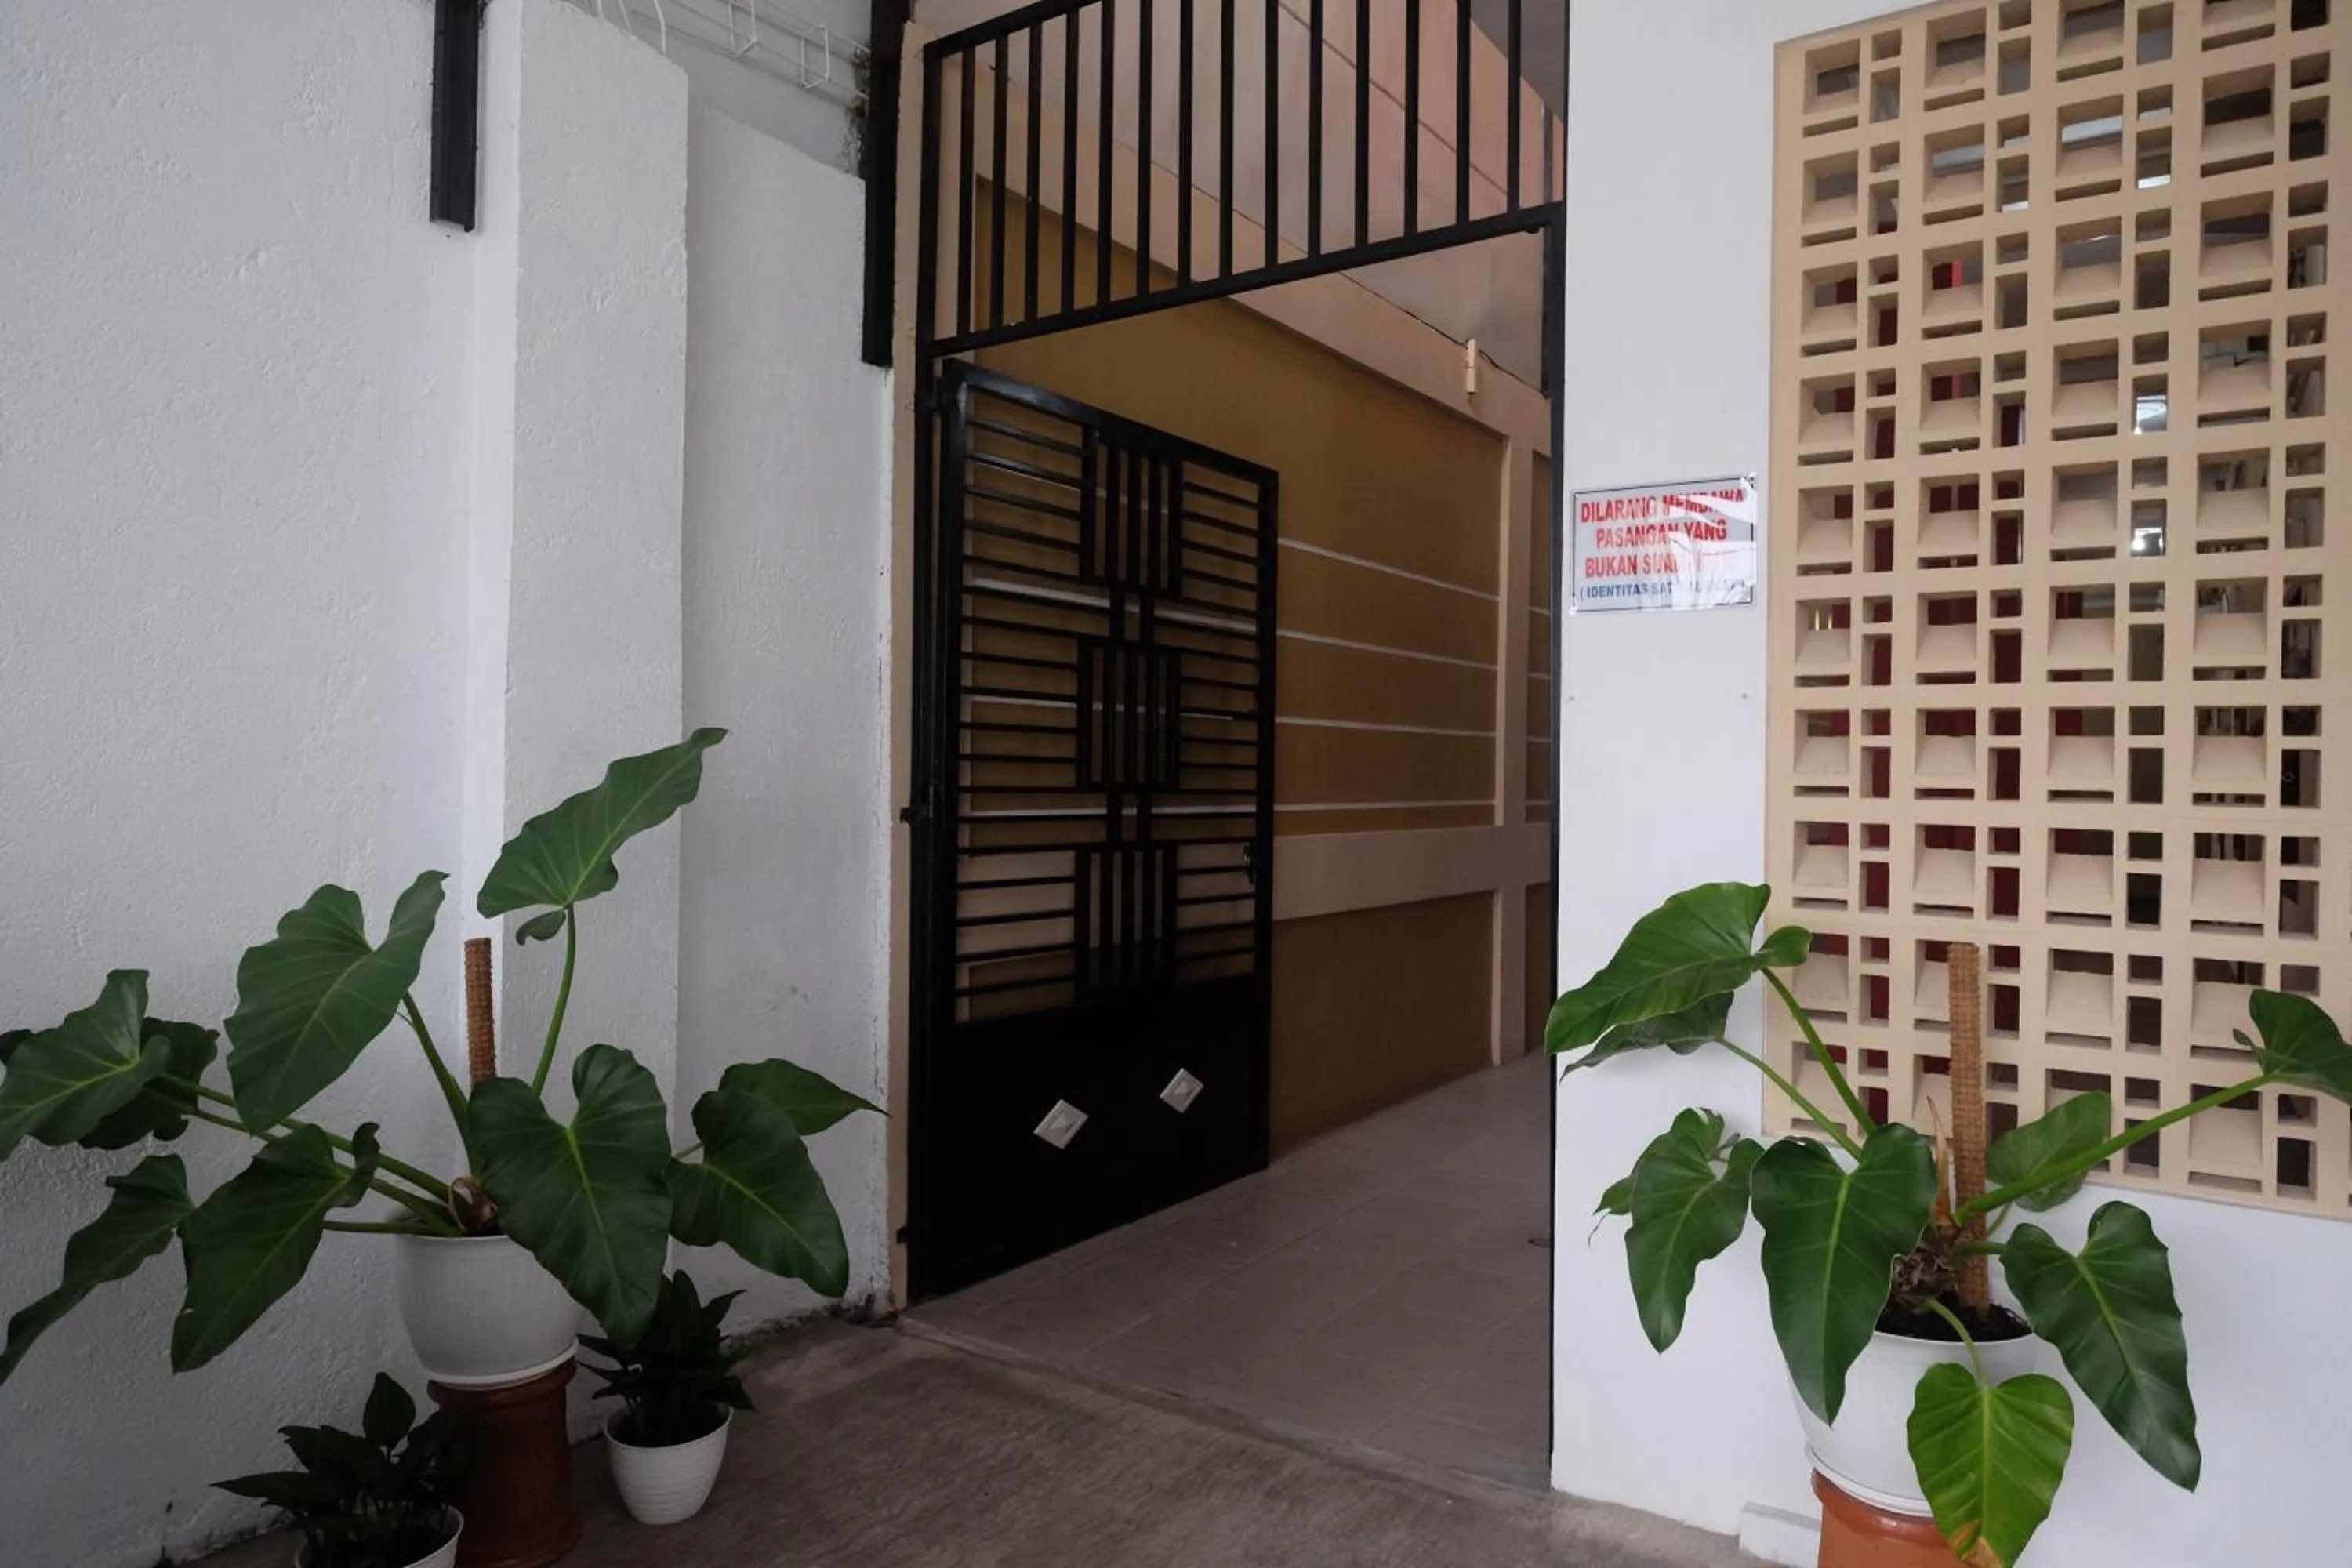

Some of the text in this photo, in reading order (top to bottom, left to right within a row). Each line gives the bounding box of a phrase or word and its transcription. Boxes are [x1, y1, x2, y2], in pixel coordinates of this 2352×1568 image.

[1581, 496, 1656, 523] DILARANG
[1684, 519, 1727, 540] YANG
[1585, 554, 1638, 578] BUKAN
